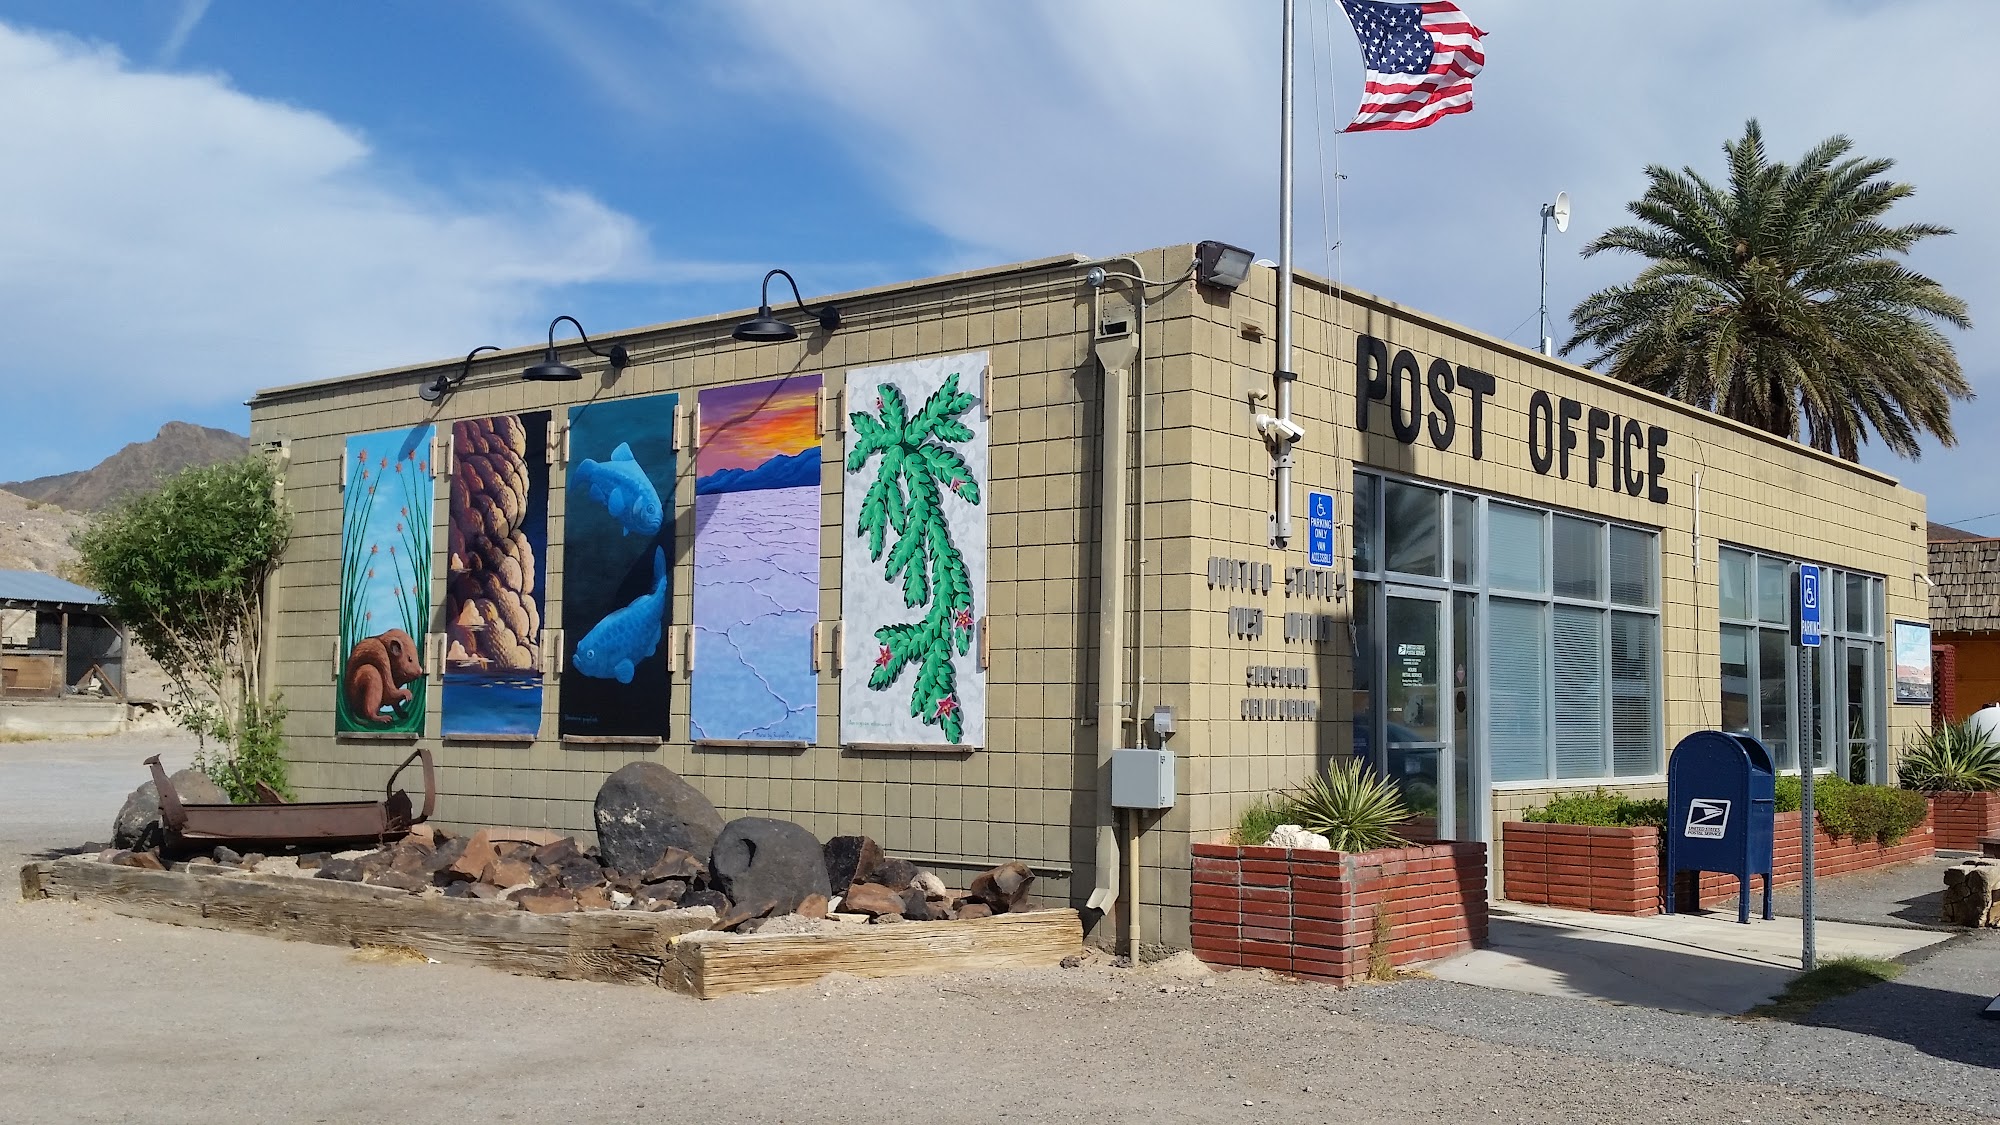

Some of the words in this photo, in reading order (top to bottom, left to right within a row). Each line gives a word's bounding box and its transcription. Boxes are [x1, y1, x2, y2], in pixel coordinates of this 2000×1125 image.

[1356, 335, 1496, 461] POST
[1529, 390, 1669, 503] OFFICE
[1311, 517, 1332, 529] PARKING
[1314, 528, 1328, 539] ONLY
[1316, 541, 1326, 551] VAN
[1311, 552, 1332, 563] ACCESSIBLE
[1208, 556, 1272, 592] UNITED
[1285, 566, 1346, 600] STATES
[1802, 620, 1821, 636] PARKING
